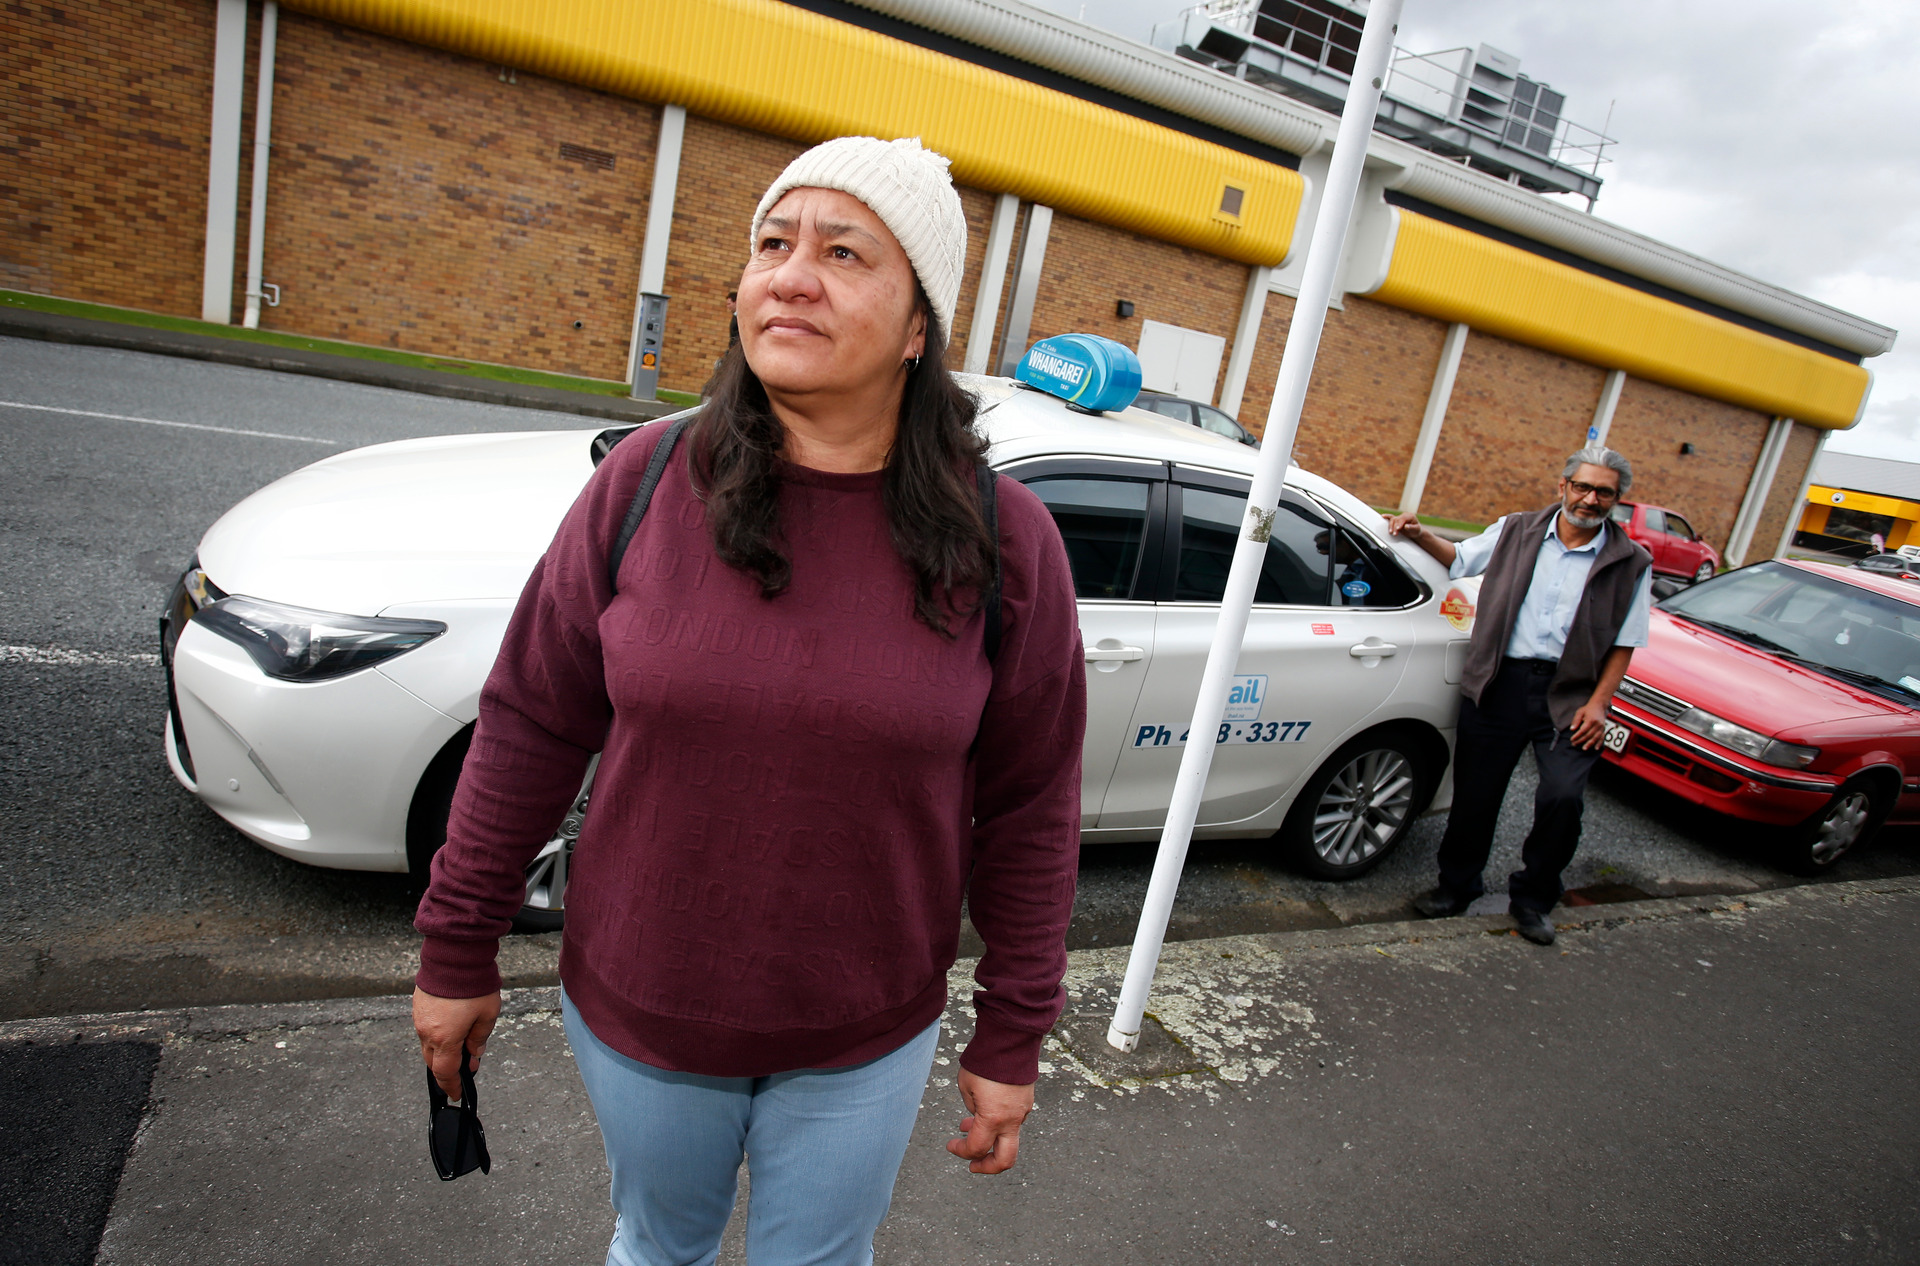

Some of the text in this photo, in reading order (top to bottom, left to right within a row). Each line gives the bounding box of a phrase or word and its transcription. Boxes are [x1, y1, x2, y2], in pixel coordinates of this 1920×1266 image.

[1028, 349, 1084, 384] WHANGAREI
[621, 604, 821, 669] LONDON
[1229, 679, 1260, 704] ail
[1134, 725, 1172, 747] Ph
[1604, 727, 1625, 748] 68
